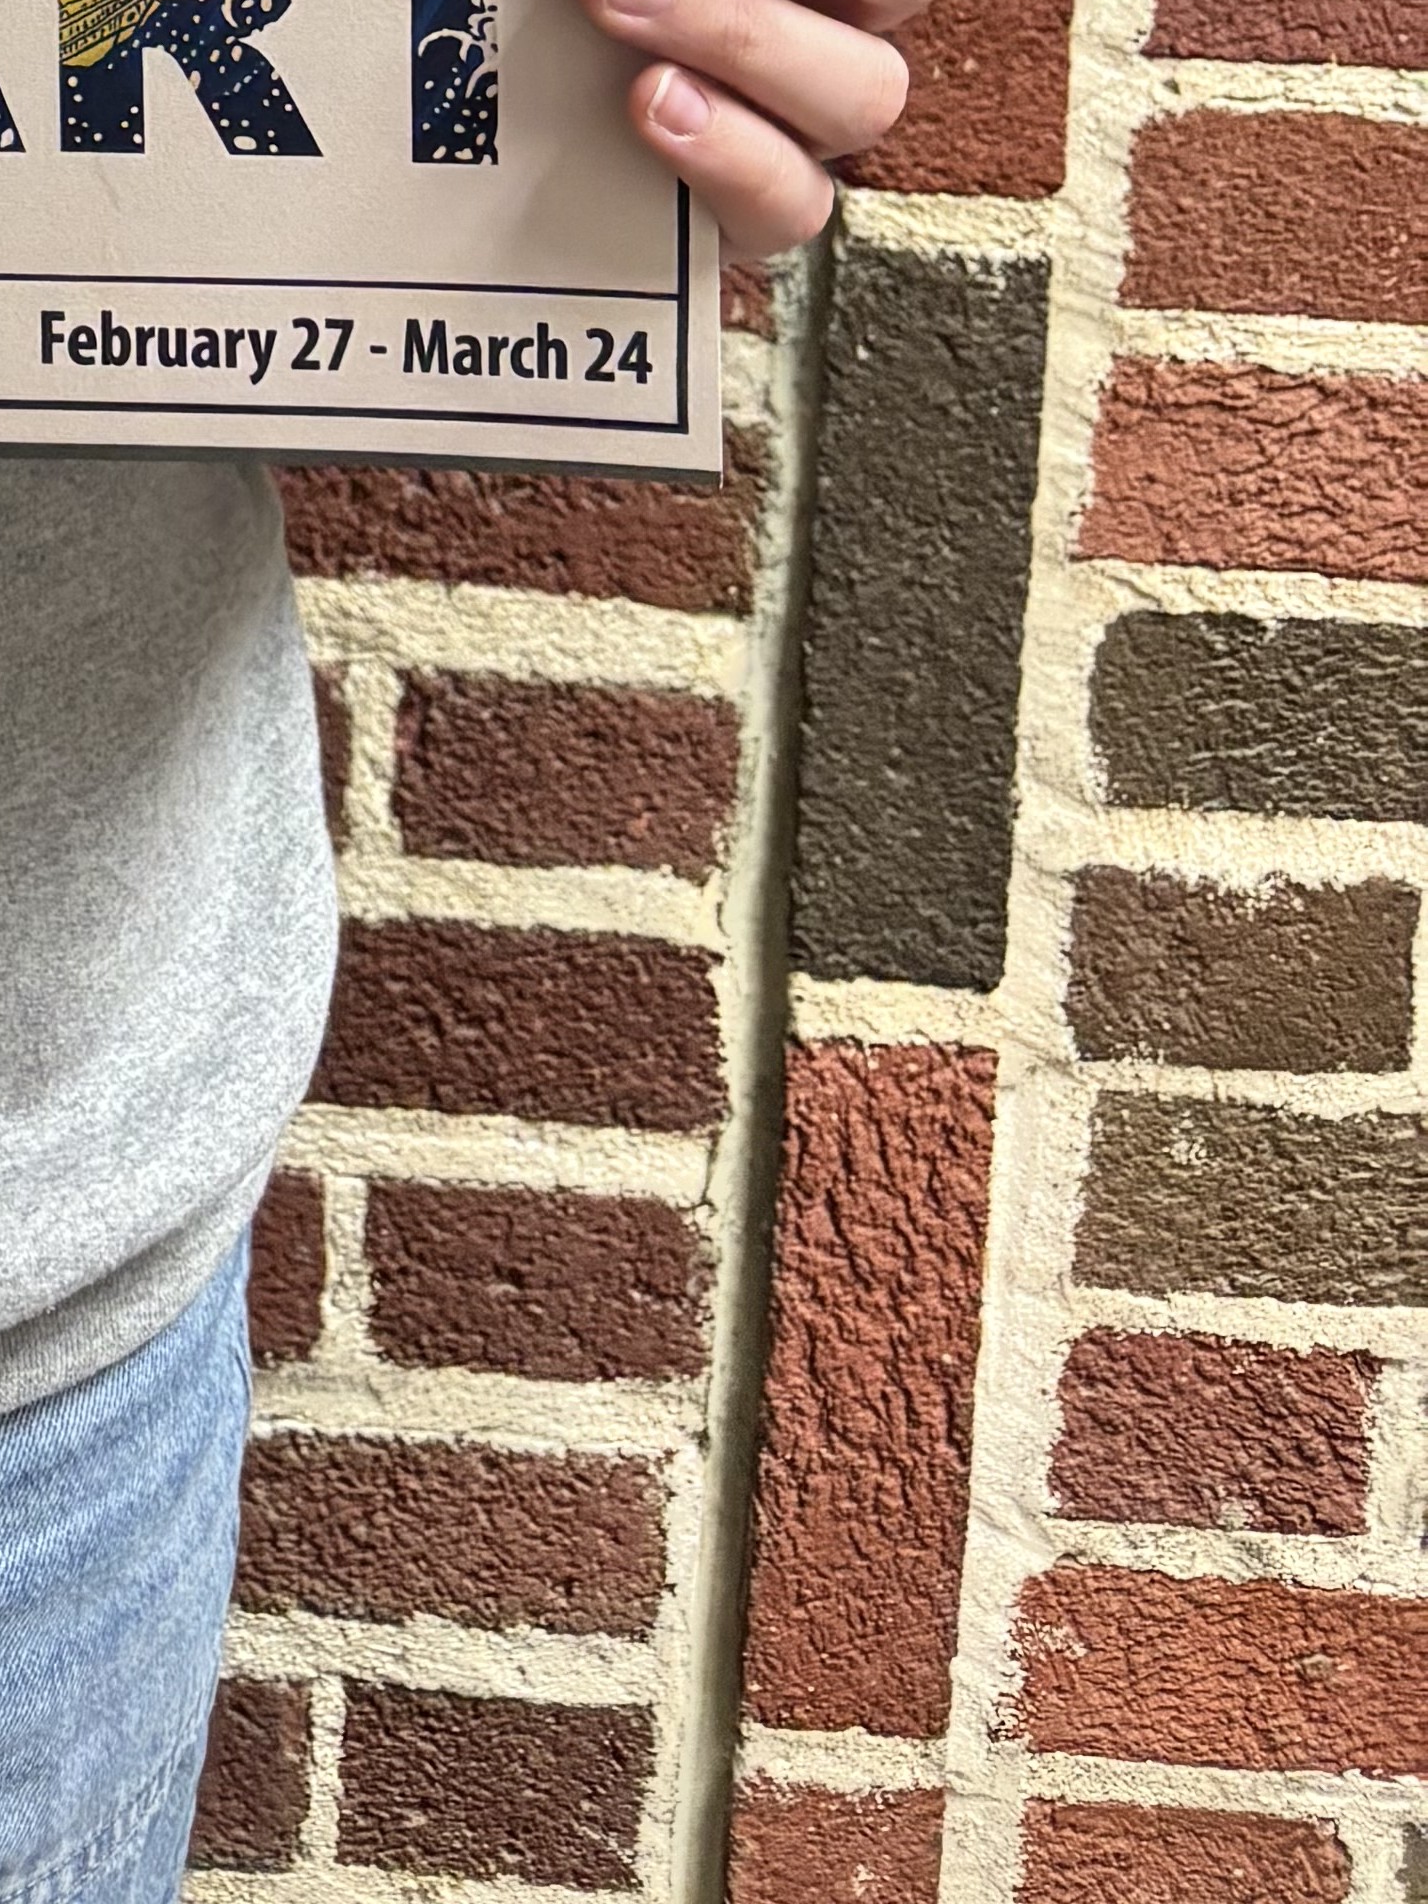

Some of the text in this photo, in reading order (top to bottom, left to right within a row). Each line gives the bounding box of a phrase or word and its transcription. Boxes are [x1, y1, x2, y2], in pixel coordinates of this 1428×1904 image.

[40, 310, 278, 385] February
[291, 318, 354, 371] 27
[402, 318, 568, 379] March
[584, 328, 653, 384] 24
